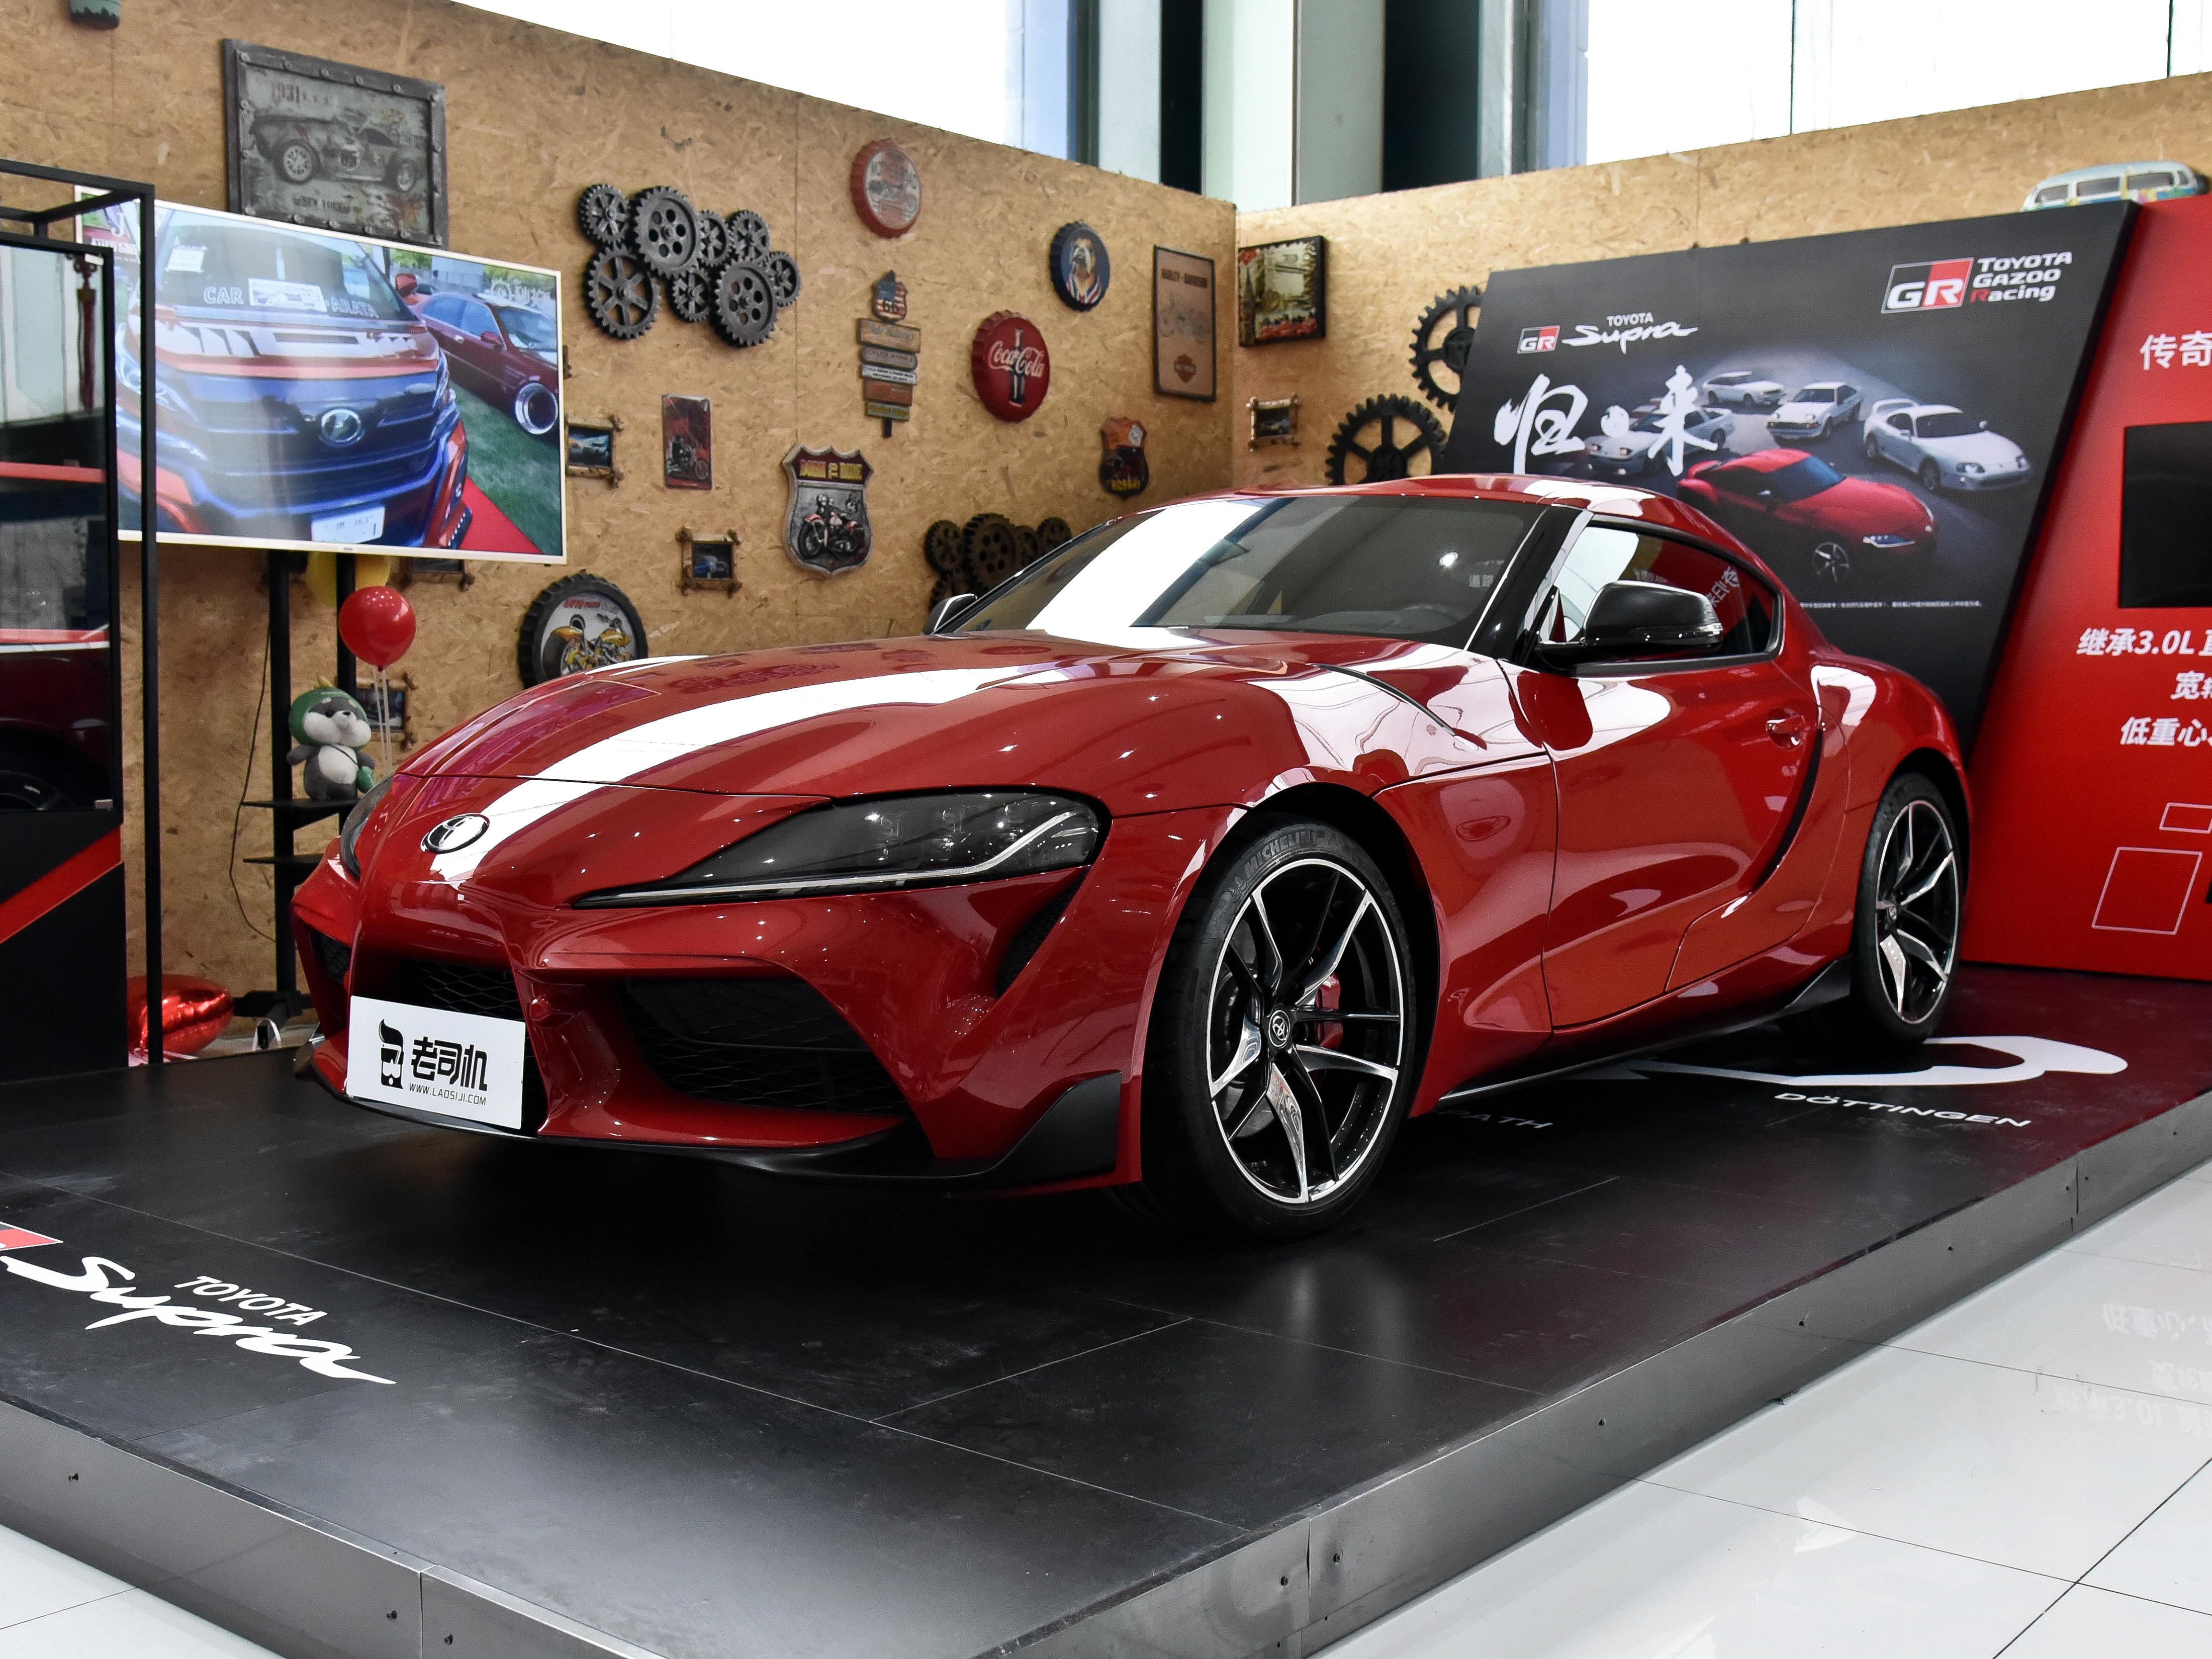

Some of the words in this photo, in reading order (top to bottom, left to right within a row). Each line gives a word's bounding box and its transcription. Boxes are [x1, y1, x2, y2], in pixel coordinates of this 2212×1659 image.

[1972, 268, 2061, 289] GAZOO
[1977, 251, 2072, 273] TOYOTA
[1886, 276, 1966, 310] GR
[1970, 285, 2056, 303] Racing
[1606, 312, 1654, 327] TOYOTA
[1519, 336, 1556, 351] GR
[1561, 321, 1699, 354] Supra
[2139, 330, 2212, 371] 传奇
[1244, 831, 1316, 879] MICHELIN
[411, 1036, 488, 1091] 老司机
[409, 1082, 487, 1106] WWW.LAOSIJI.COM
[1775, 1092, 2032, 1127] DÖTTINGEN
[174, 1275, 327, 1326] TOYOTA
[0, 1256, 397, 1385] Supra
